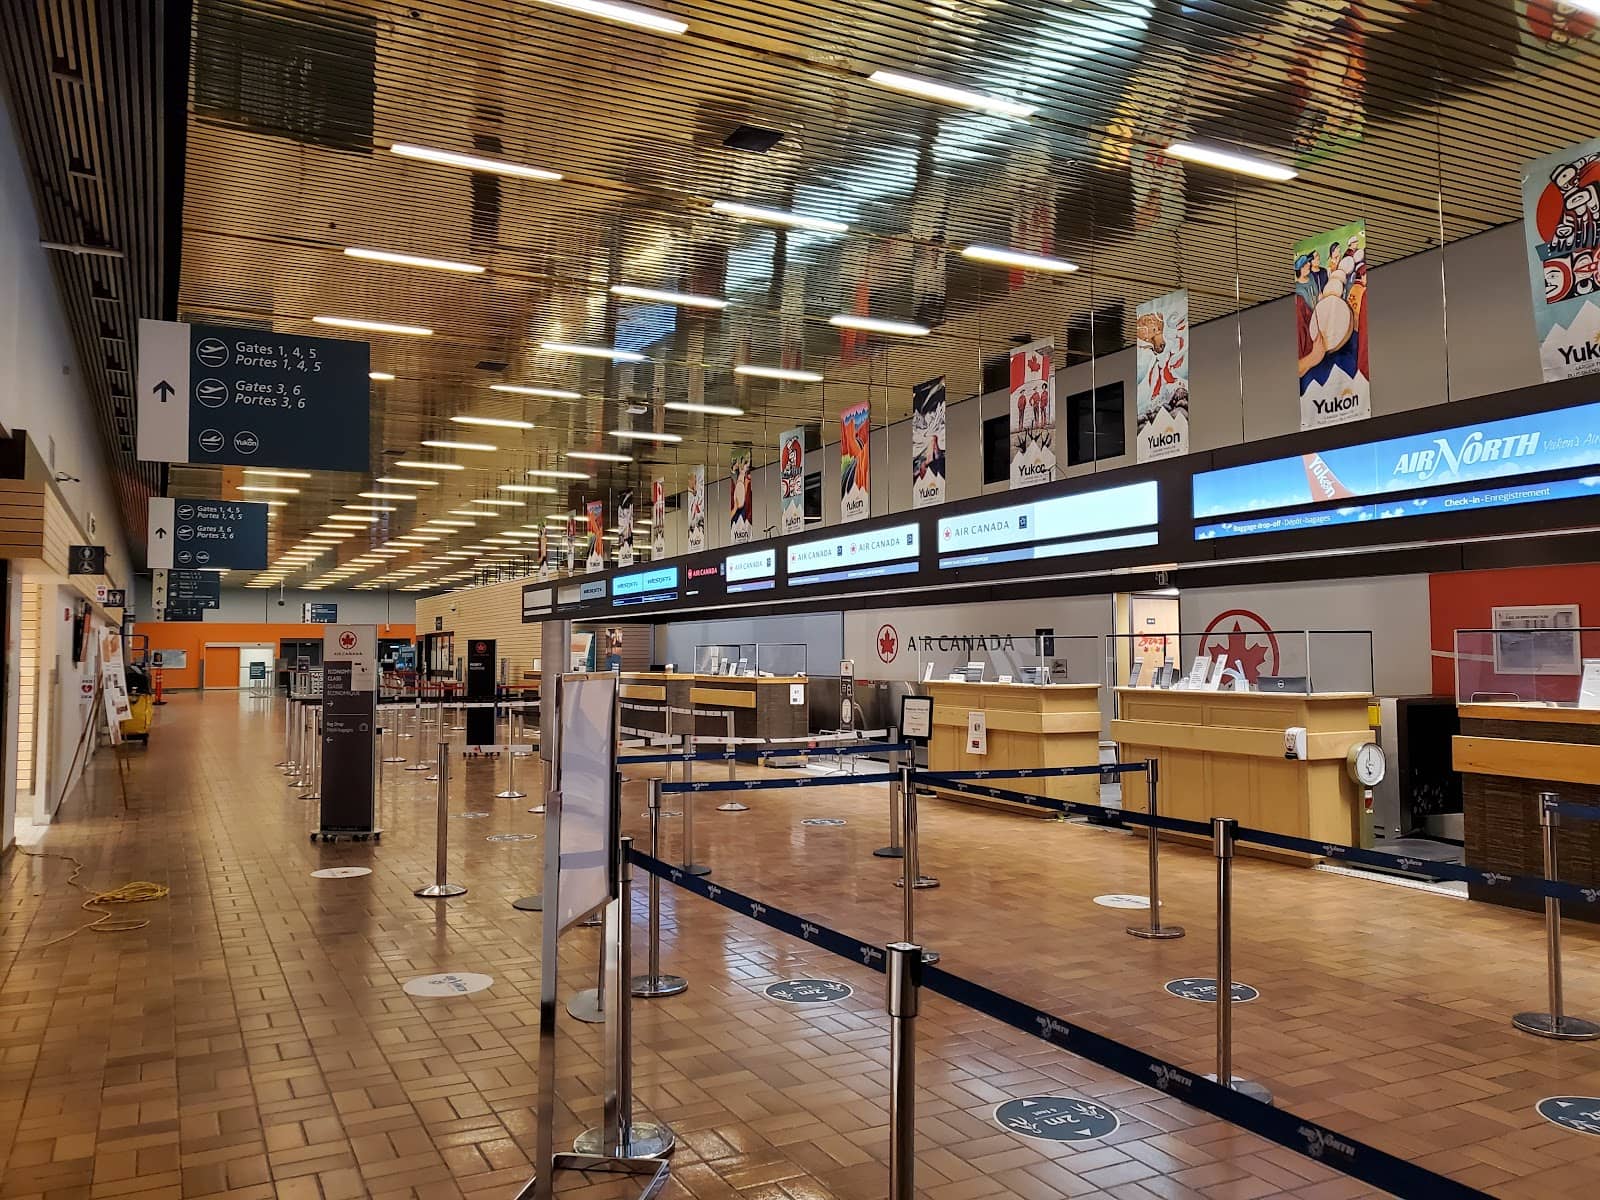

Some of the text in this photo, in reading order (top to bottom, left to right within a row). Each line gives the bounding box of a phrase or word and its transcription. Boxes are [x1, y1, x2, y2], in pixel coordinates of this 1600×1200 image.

[235, 341, 317, 360] Gates 1, 4, 5
[1558, 339, 1600, 366] Yuk
[235, 354, 322, 372] Portes 1, 4, 5
[235, 380, 301, 396] Gates 3, 6
[234, 393, 306, 409] Portes 3, 6
[1313, 393, 1359, 415] Yukon
[1147, 431, 1180, 449] Yukon
[1393, 450, 1435, 475] AIR
[1419, 431, 1541, 480] NORTH
[1307, 453, 1335, 499] Yukon
[1444, 487, 1551, 508] Check-in Enregistrement
[197, 505, 217, 513] Gates
[197, 525, 217, 533] Gates
[955, 520, 1010, 537] AIR CANADA
[858, 537, 900, 553] AIR CANADA
[797, 548, 832, 561] AIR CANADA
[744, 560, 763, 570] CANADA
[938, 633, 1015, 652] CANADA
[1044, 1114, 1081, 1126] 2m
